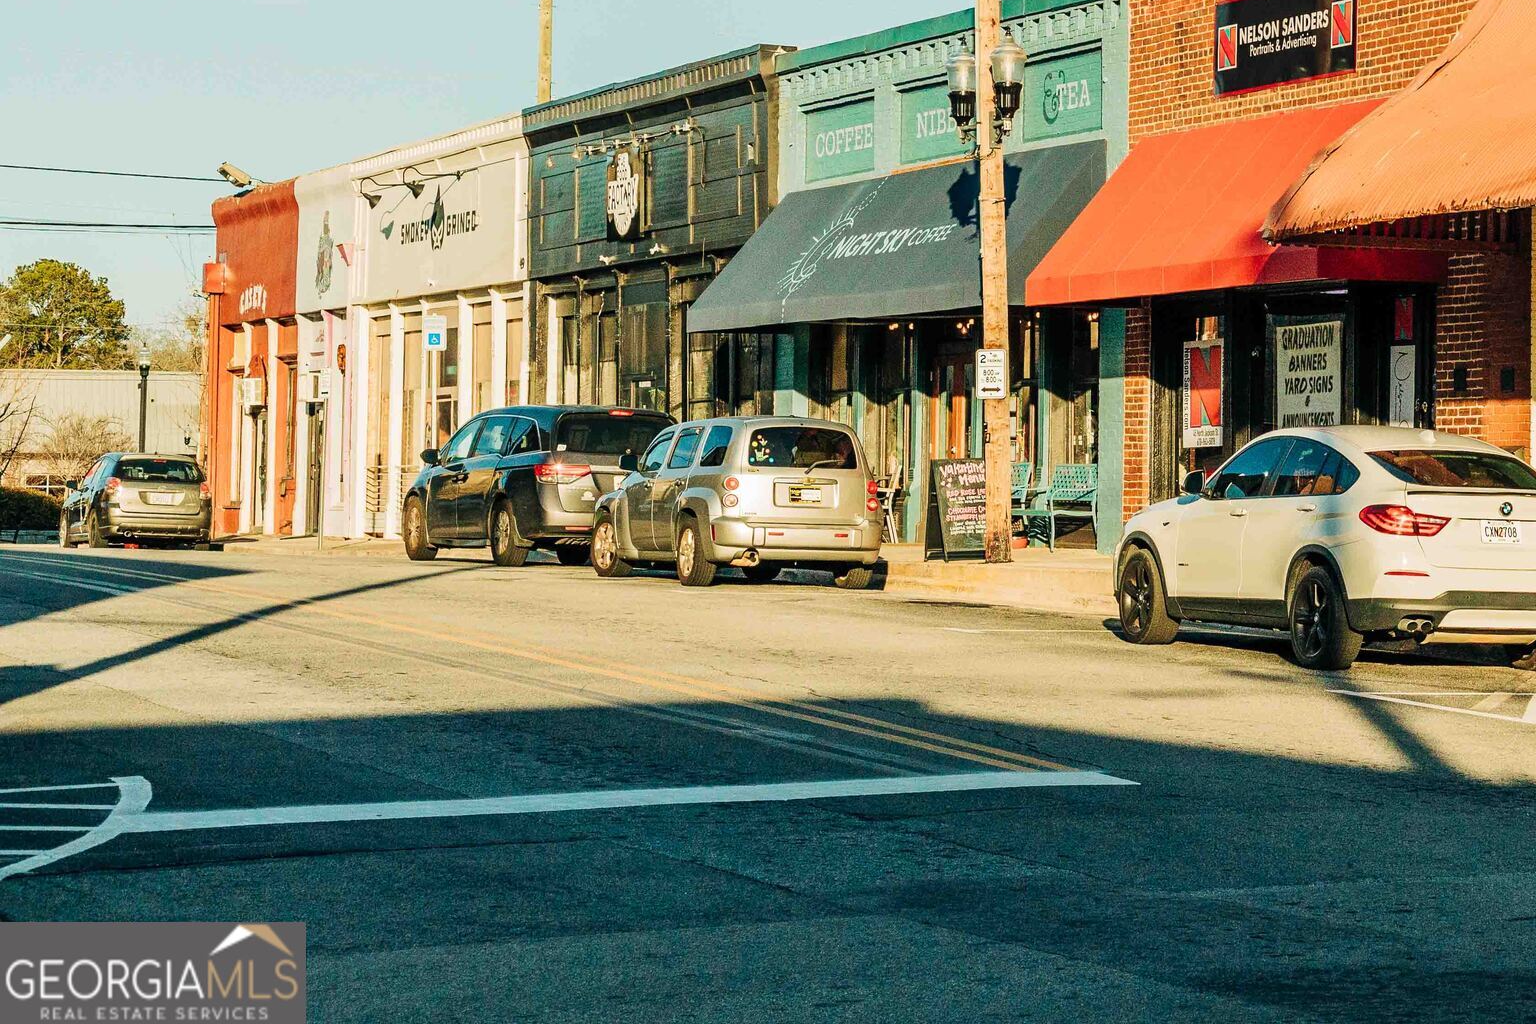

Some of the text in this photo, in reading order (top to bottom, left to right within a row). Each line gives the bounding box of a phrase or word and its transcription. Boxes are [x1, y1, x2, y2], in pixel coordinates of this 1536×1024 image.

[1239, 9, 1329, 45] NELSON SANDERS
[1249, 33, 1317, 57] Portraits & Advertising
[1056, 79, 1091, 111] TEA
[815, 123, 873, 158] COFFEE
[401, 210, 476, 245] SMOKEY GRINGO
[827, 224, 957, 259] NIGHT SKY COFFEE
[1282, 326, 1334, 350] GRADUATION
[980, 354, 987, 363] 2
[1288, 353, 1327, 372] BANNERS
[1284, 375, 1334, 395] YARD SIGNS
[1282, 412, 1335, 428] ANNOUNCEMENTS
[958, 473, 986, 486] Menu
[1484, 526, 1518, 538] CXN2708
